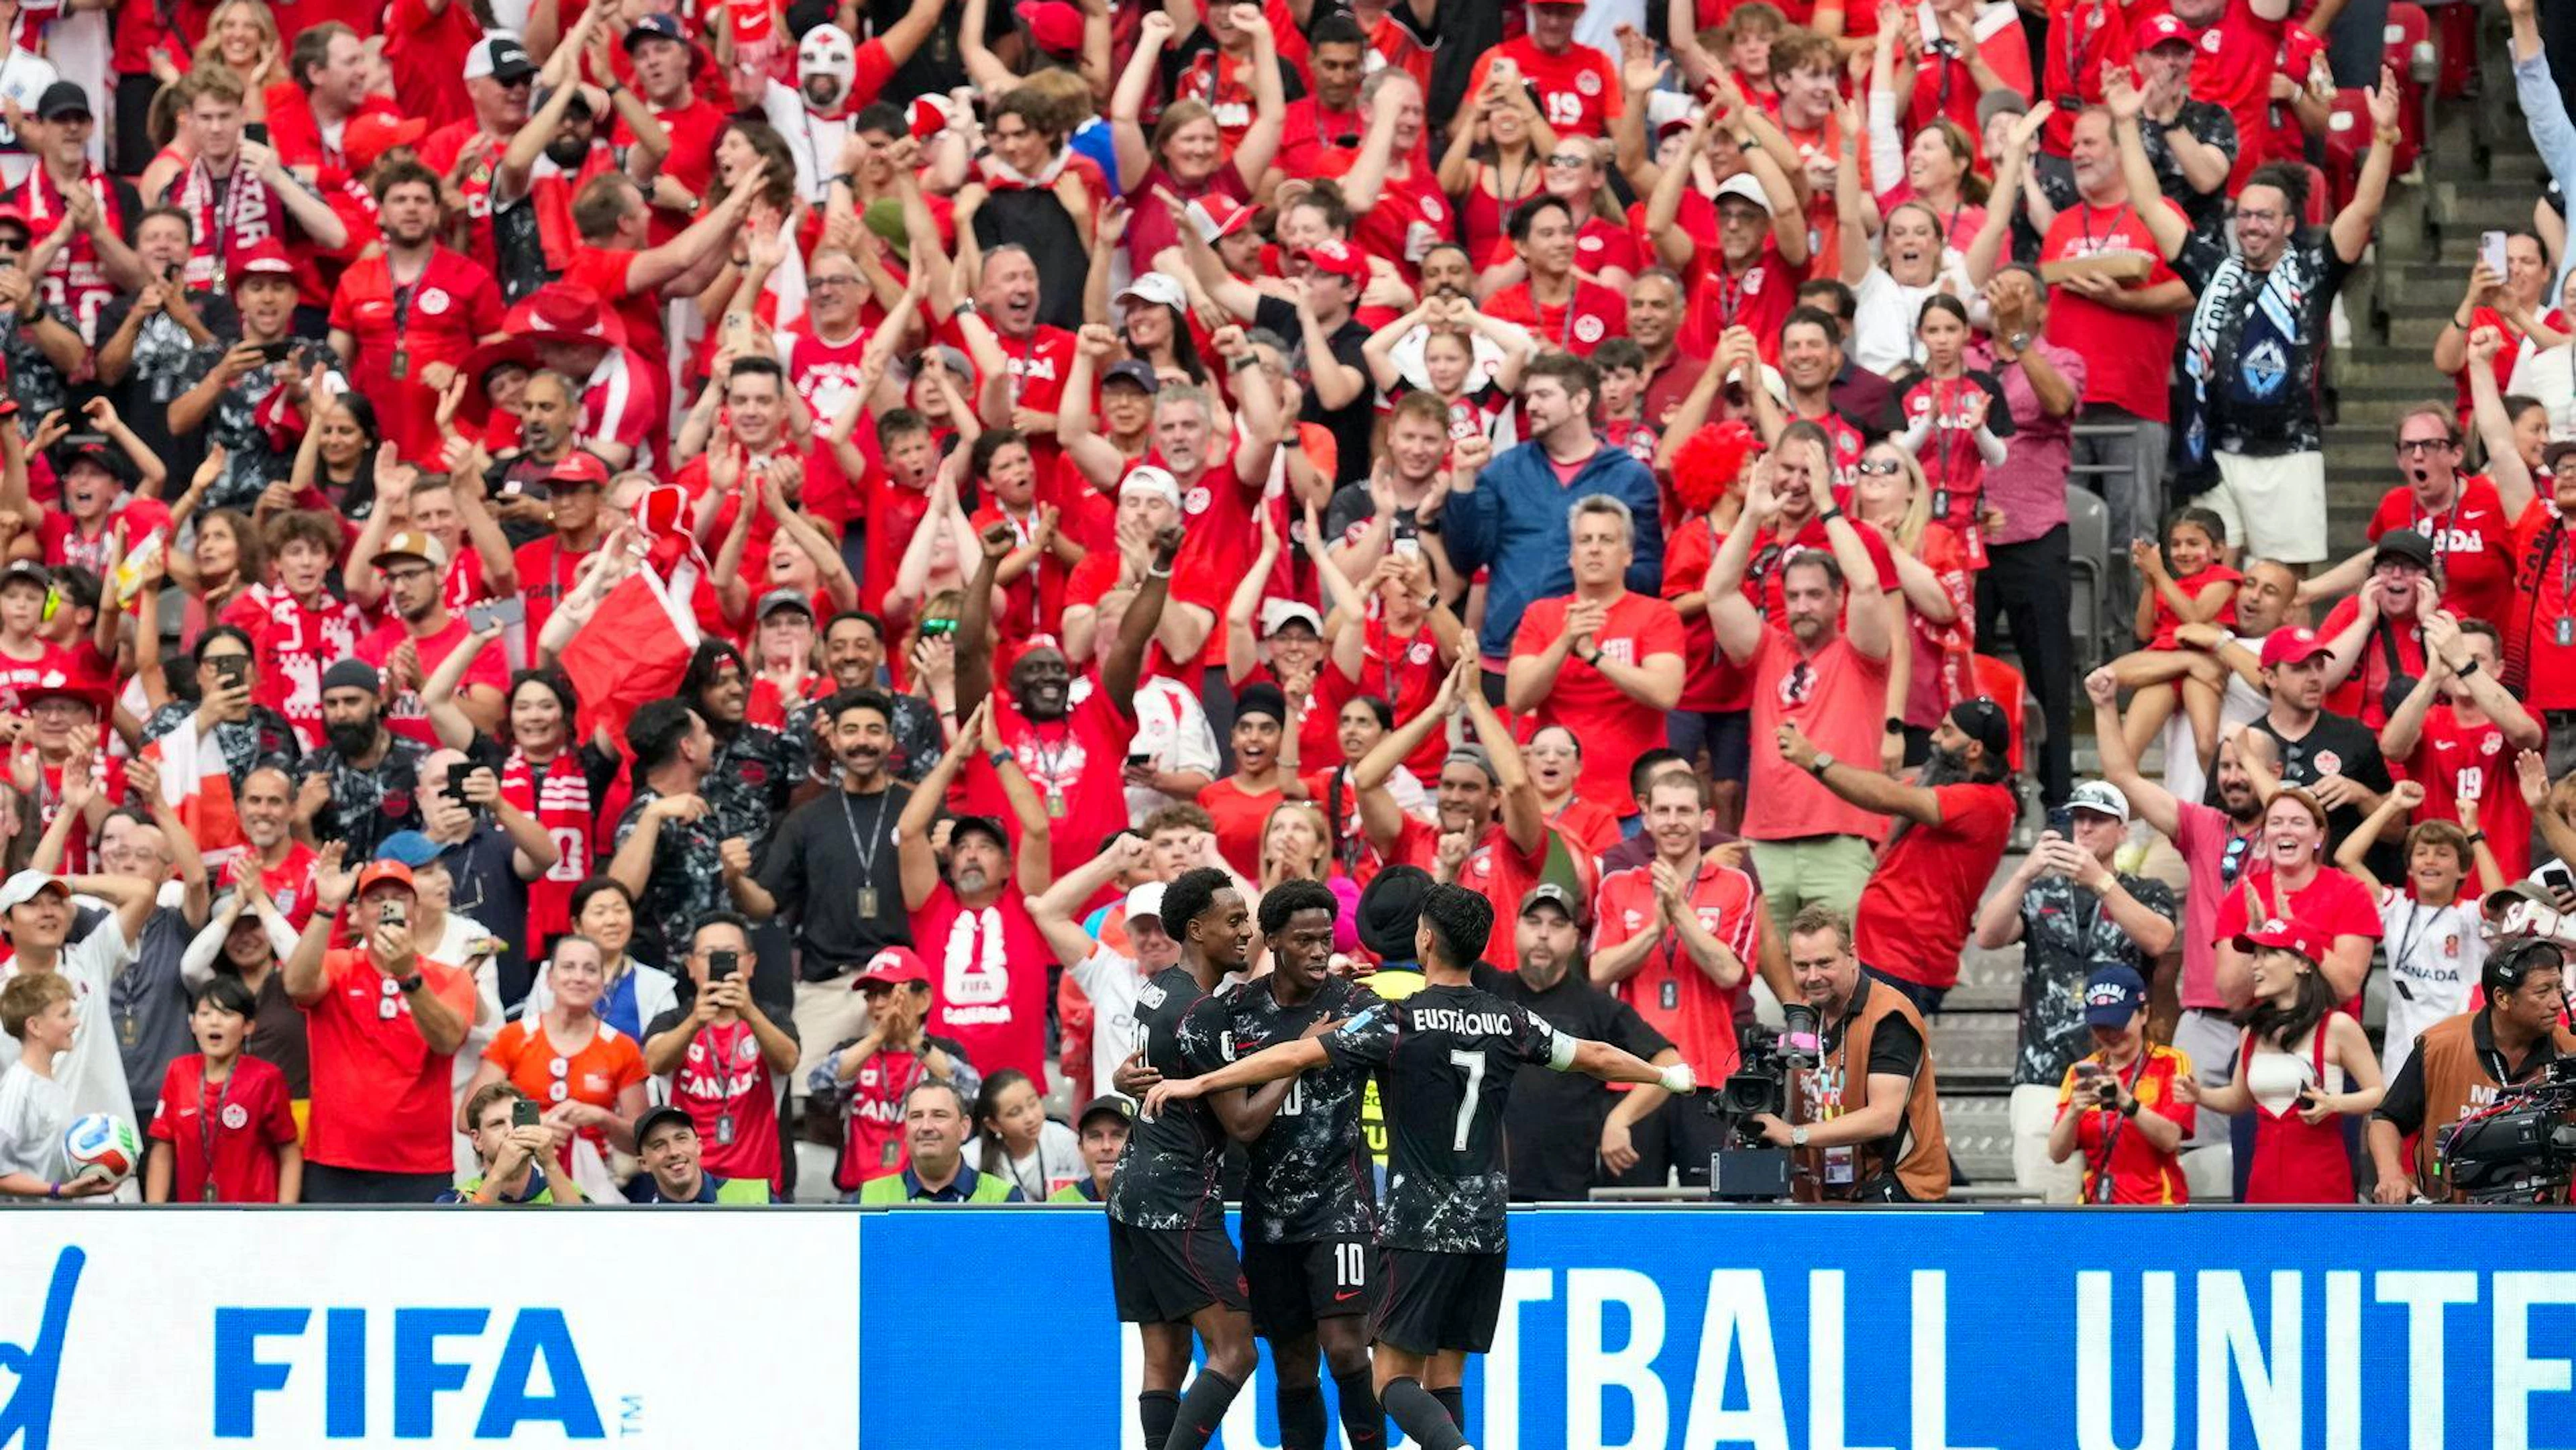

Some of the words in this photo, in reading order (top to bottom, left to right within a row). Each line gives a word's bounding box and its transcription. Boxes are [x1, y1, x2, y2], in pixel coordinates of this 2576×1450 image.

[1548, 92, 1582, 125] 19
[2433, 528, 2483, 552] ADA
[2457, 766, 2482, 799] 19
[1450, 1049, 1486, 1151] 7
[1334, 1243, 1364, 1286] 10
[215, 1308, 606, 1438] FIFA
[1120, 1268, 2001, 1450] TBALL
